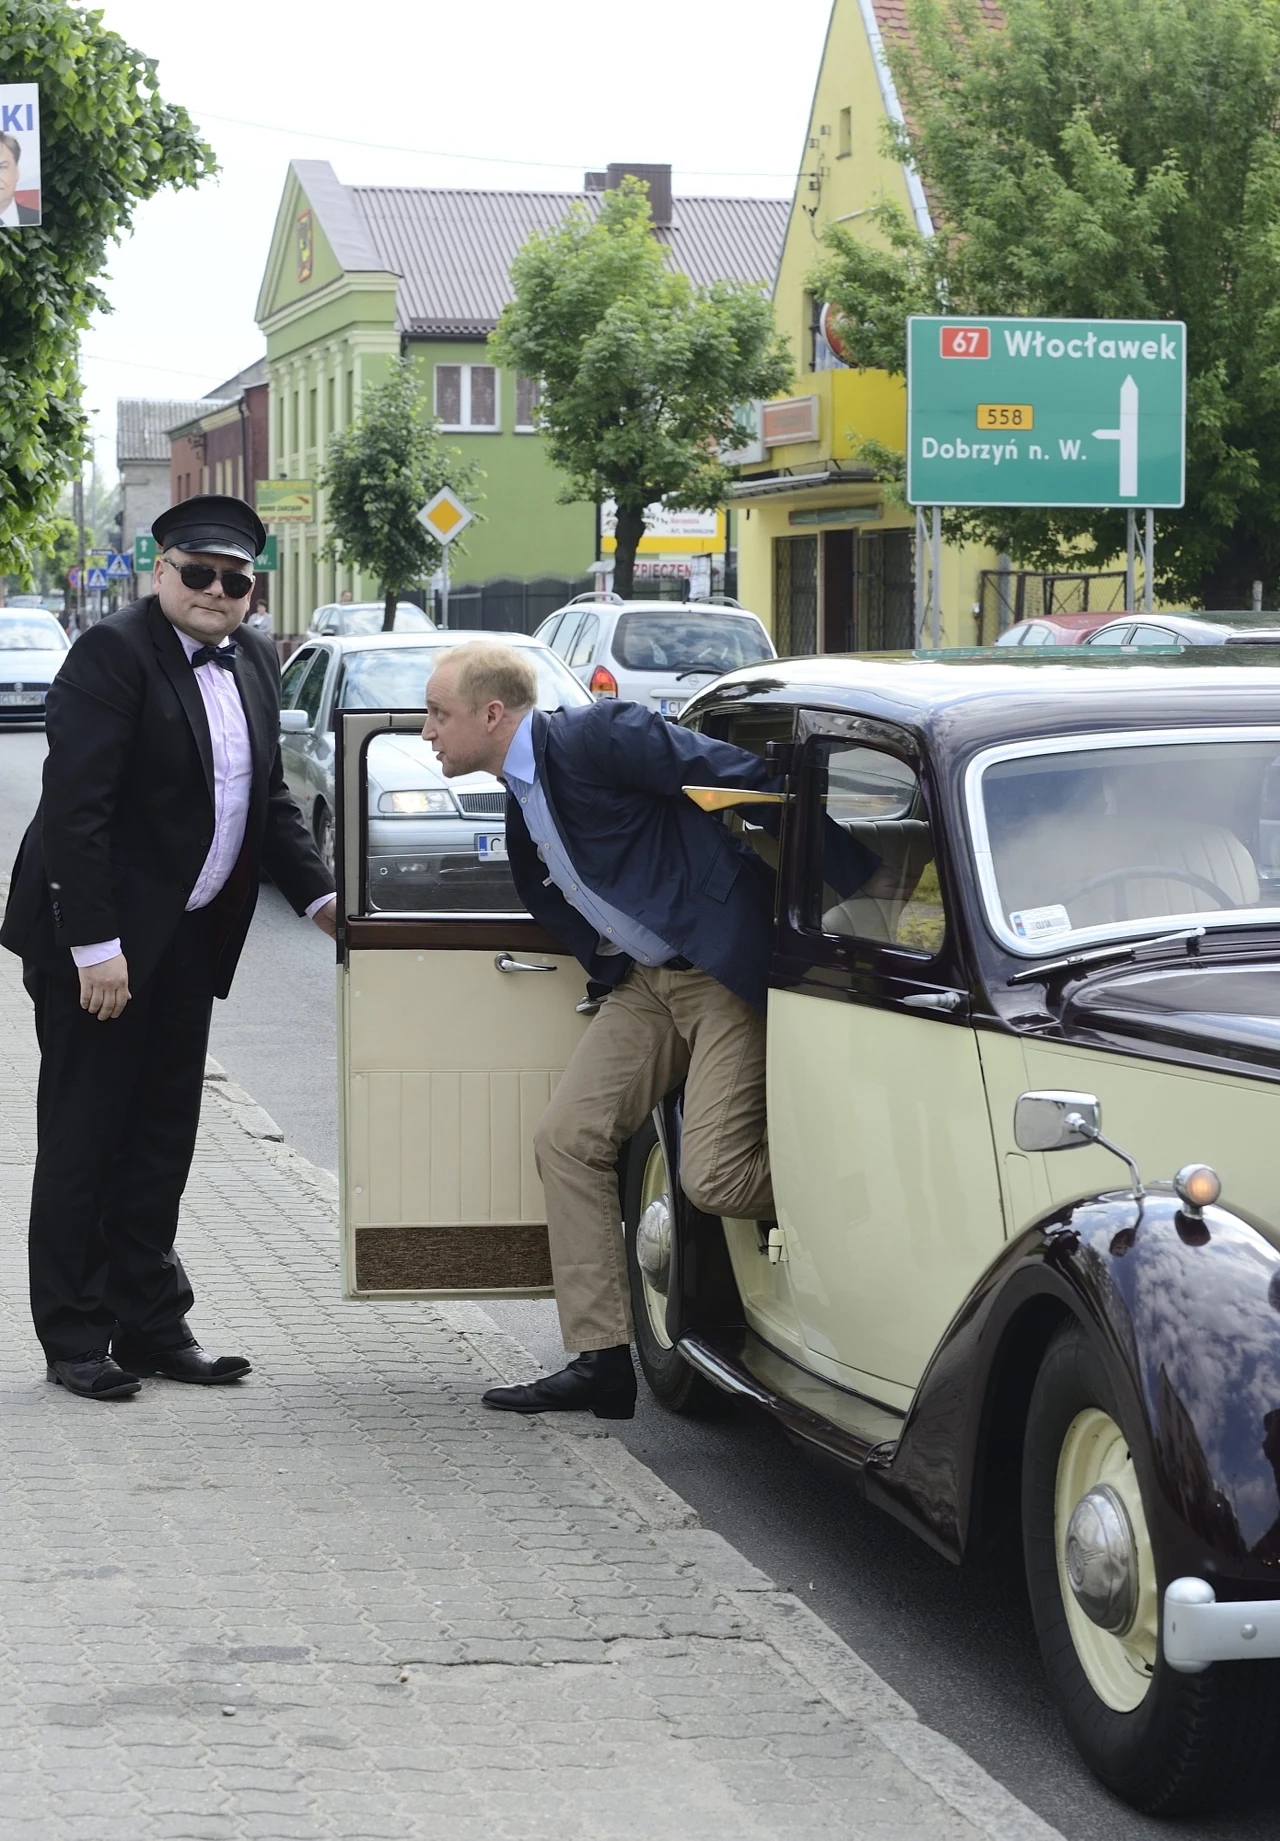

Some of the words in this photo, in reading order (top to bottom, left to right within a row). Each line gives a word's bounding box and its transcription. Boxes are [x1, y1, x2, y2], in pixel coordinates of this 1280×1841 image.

[2, 103, 34, 133] KI
[952, 331, 980, 354] 67
[1003, 329, 1177, 360] Włocławek
[987, 408, 1023, 426] 558
[921, 437, 1019, 466] Dobrzyń
[1029, 444, 1050, 461] n.
[1059, 439, 1087, 461] W.
